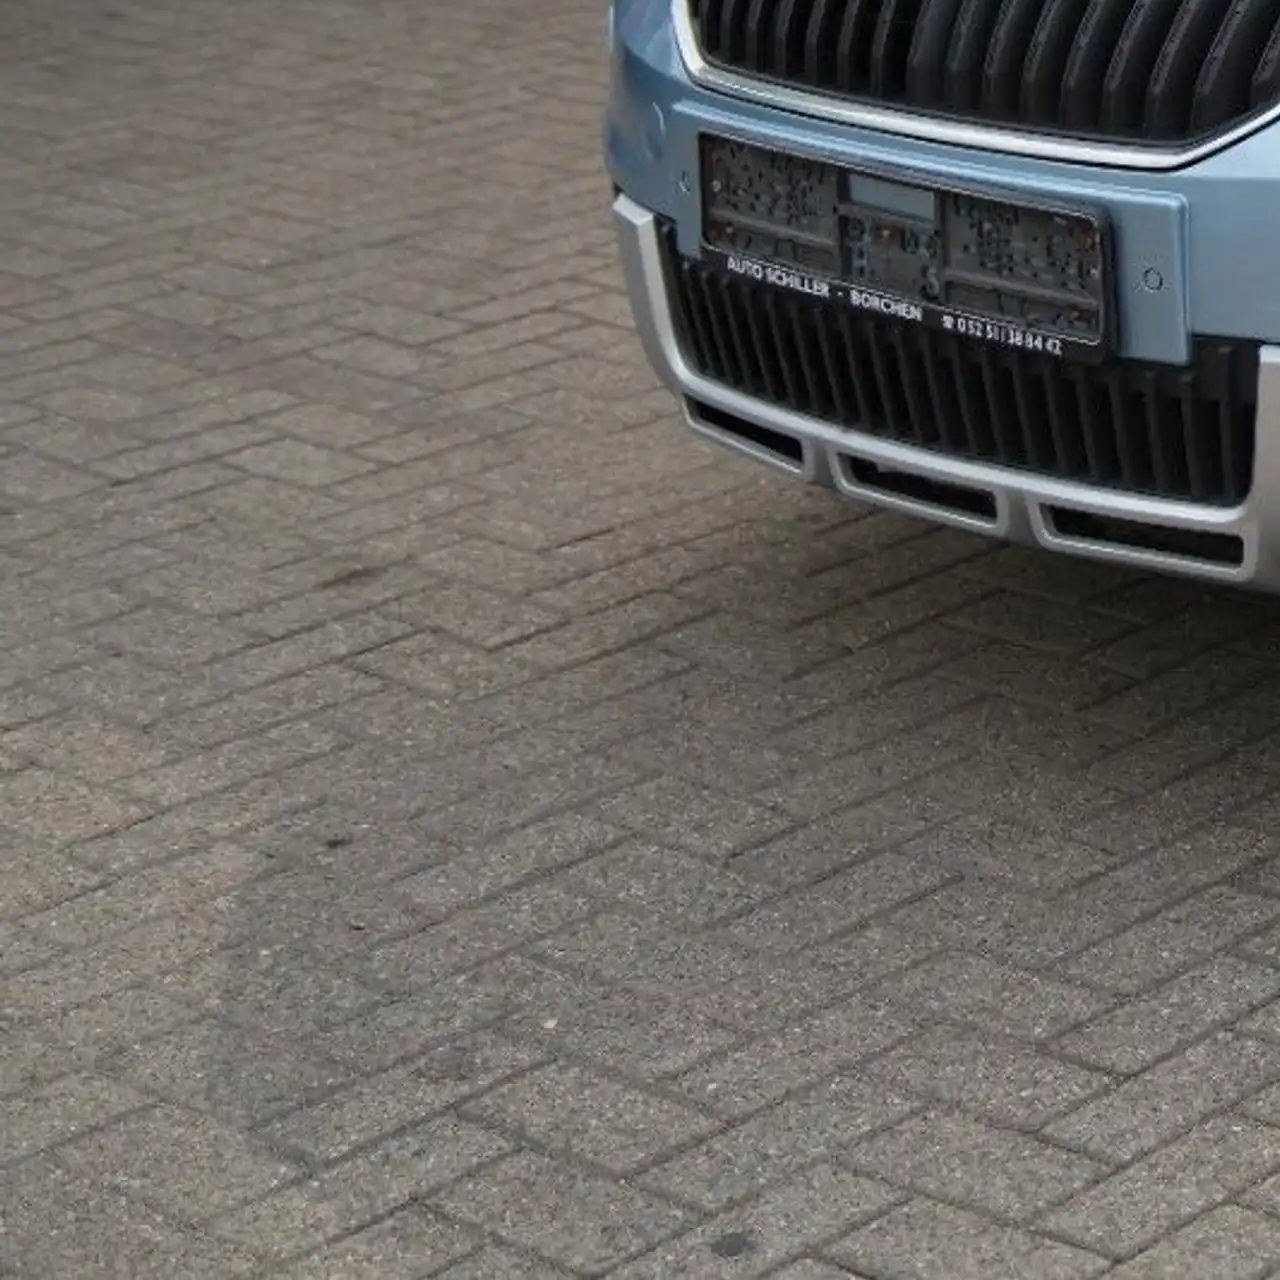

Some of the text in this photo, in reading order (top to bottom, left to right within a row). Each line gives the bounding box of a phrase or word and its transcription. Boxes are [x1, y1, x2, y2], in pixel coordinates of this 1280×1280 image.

[727, 256, 762, 281] AUTO
[766, 267, 829, 298] SCHILLER
[850, 289, 922, 321] BORCHEN
